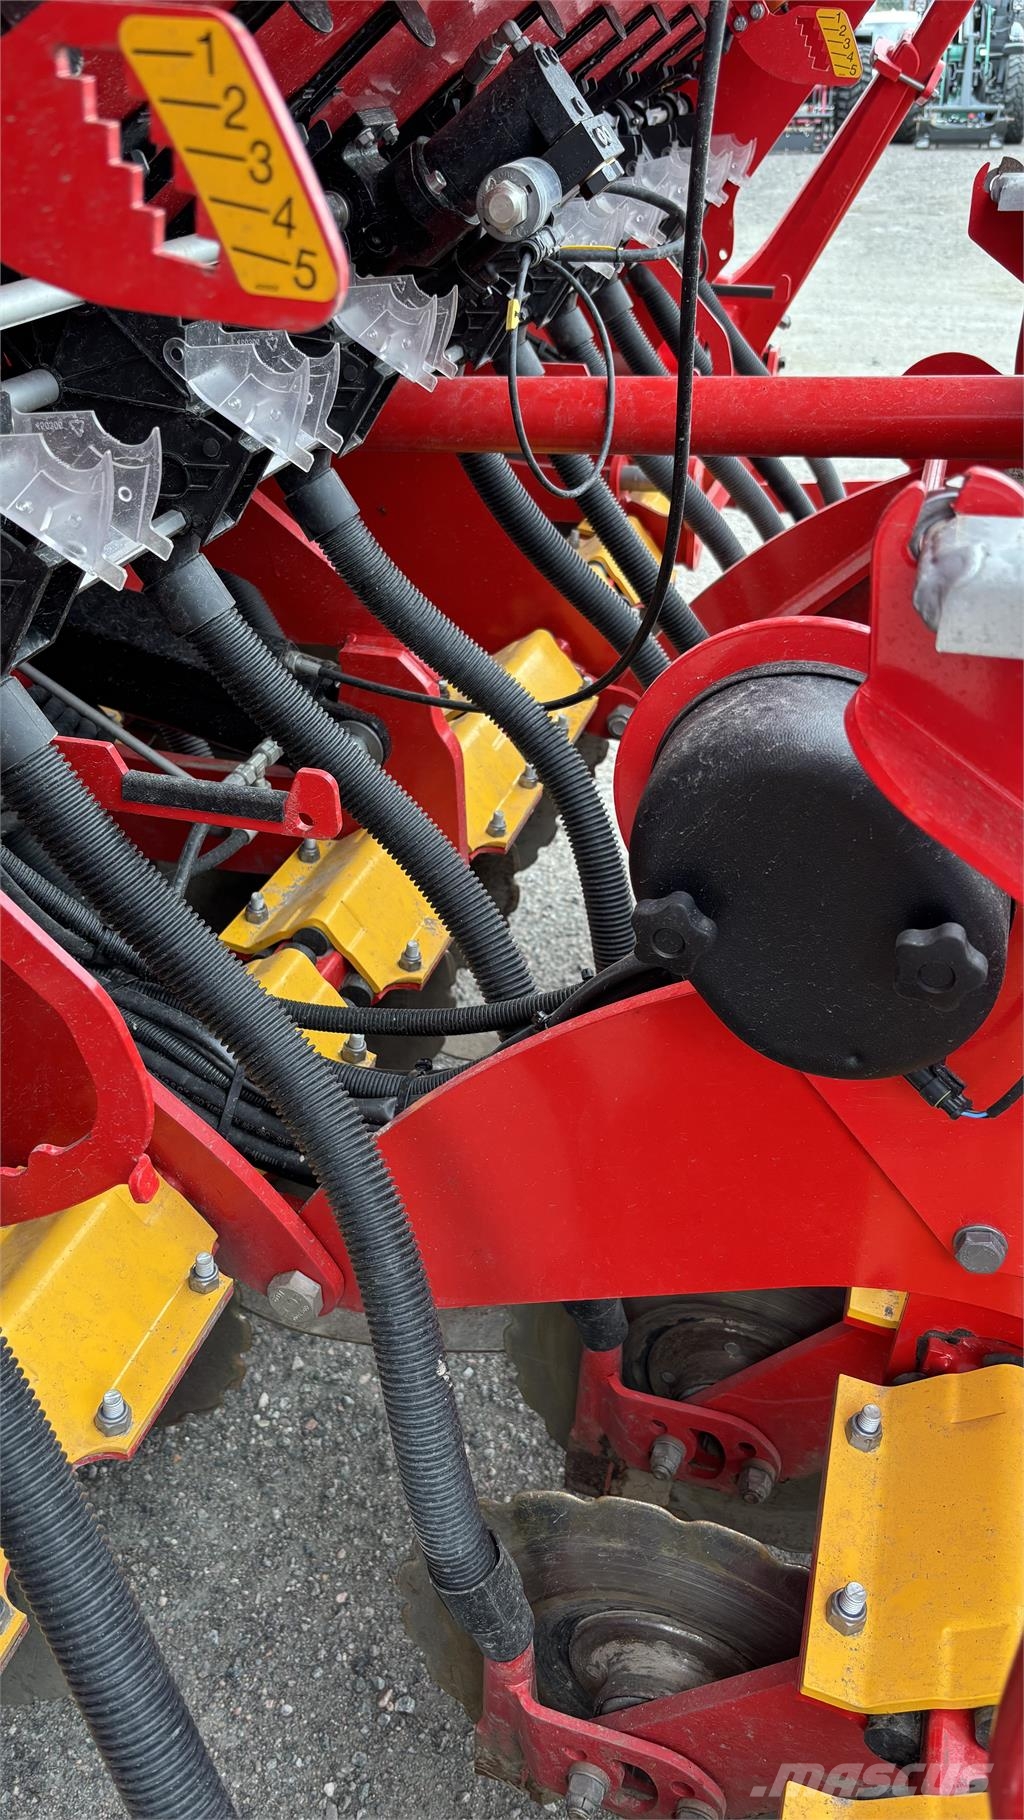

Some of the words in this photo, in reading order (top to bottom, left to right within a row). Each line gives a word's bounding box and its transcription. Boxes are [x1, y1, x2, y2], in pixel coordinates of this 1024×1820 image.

[836, 12, 841, 23] 1
[839, 25, 847, 36] 2
[196, 30, 215, 76] 1
[843, 38, 850, 49] 3
[846, 52, 854, 62] 4
[850, 65, 858, 75] 5
[222, 85, 248, 132] 2
[248, 139, 274, 185] 3
[271, 196, 297, 240] 4
[292, 248, 318, 291] 5
